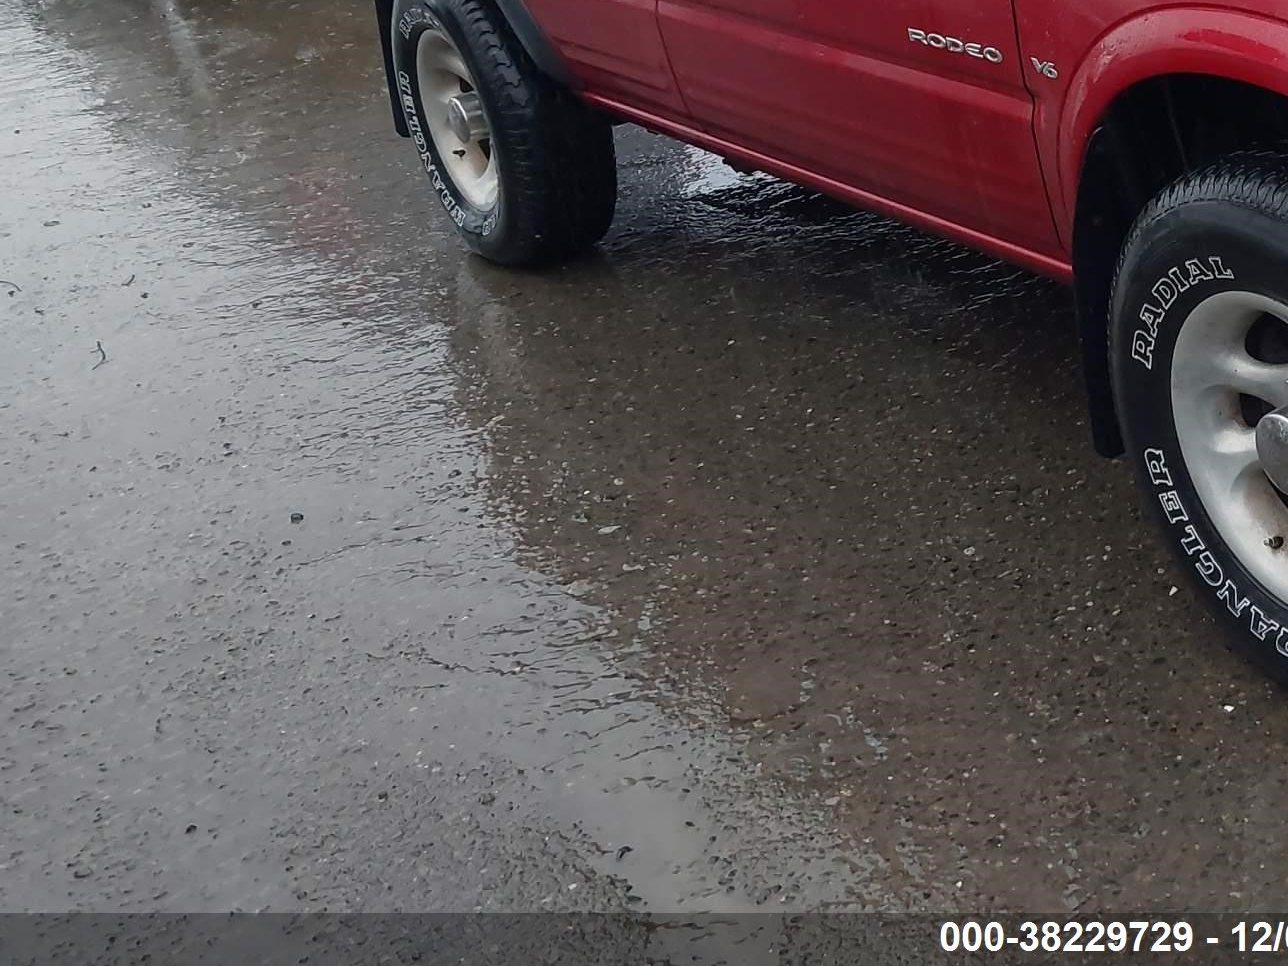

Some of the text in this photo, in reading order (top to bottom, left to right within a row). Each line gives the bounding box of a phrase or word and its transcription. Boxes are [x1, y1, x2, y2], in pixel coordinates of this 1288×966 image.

[907, 27, 1003, 64] RODEO
[1030, 57, 1058, 79] V6
[1131, 255, 1235, 370] RADIAL
